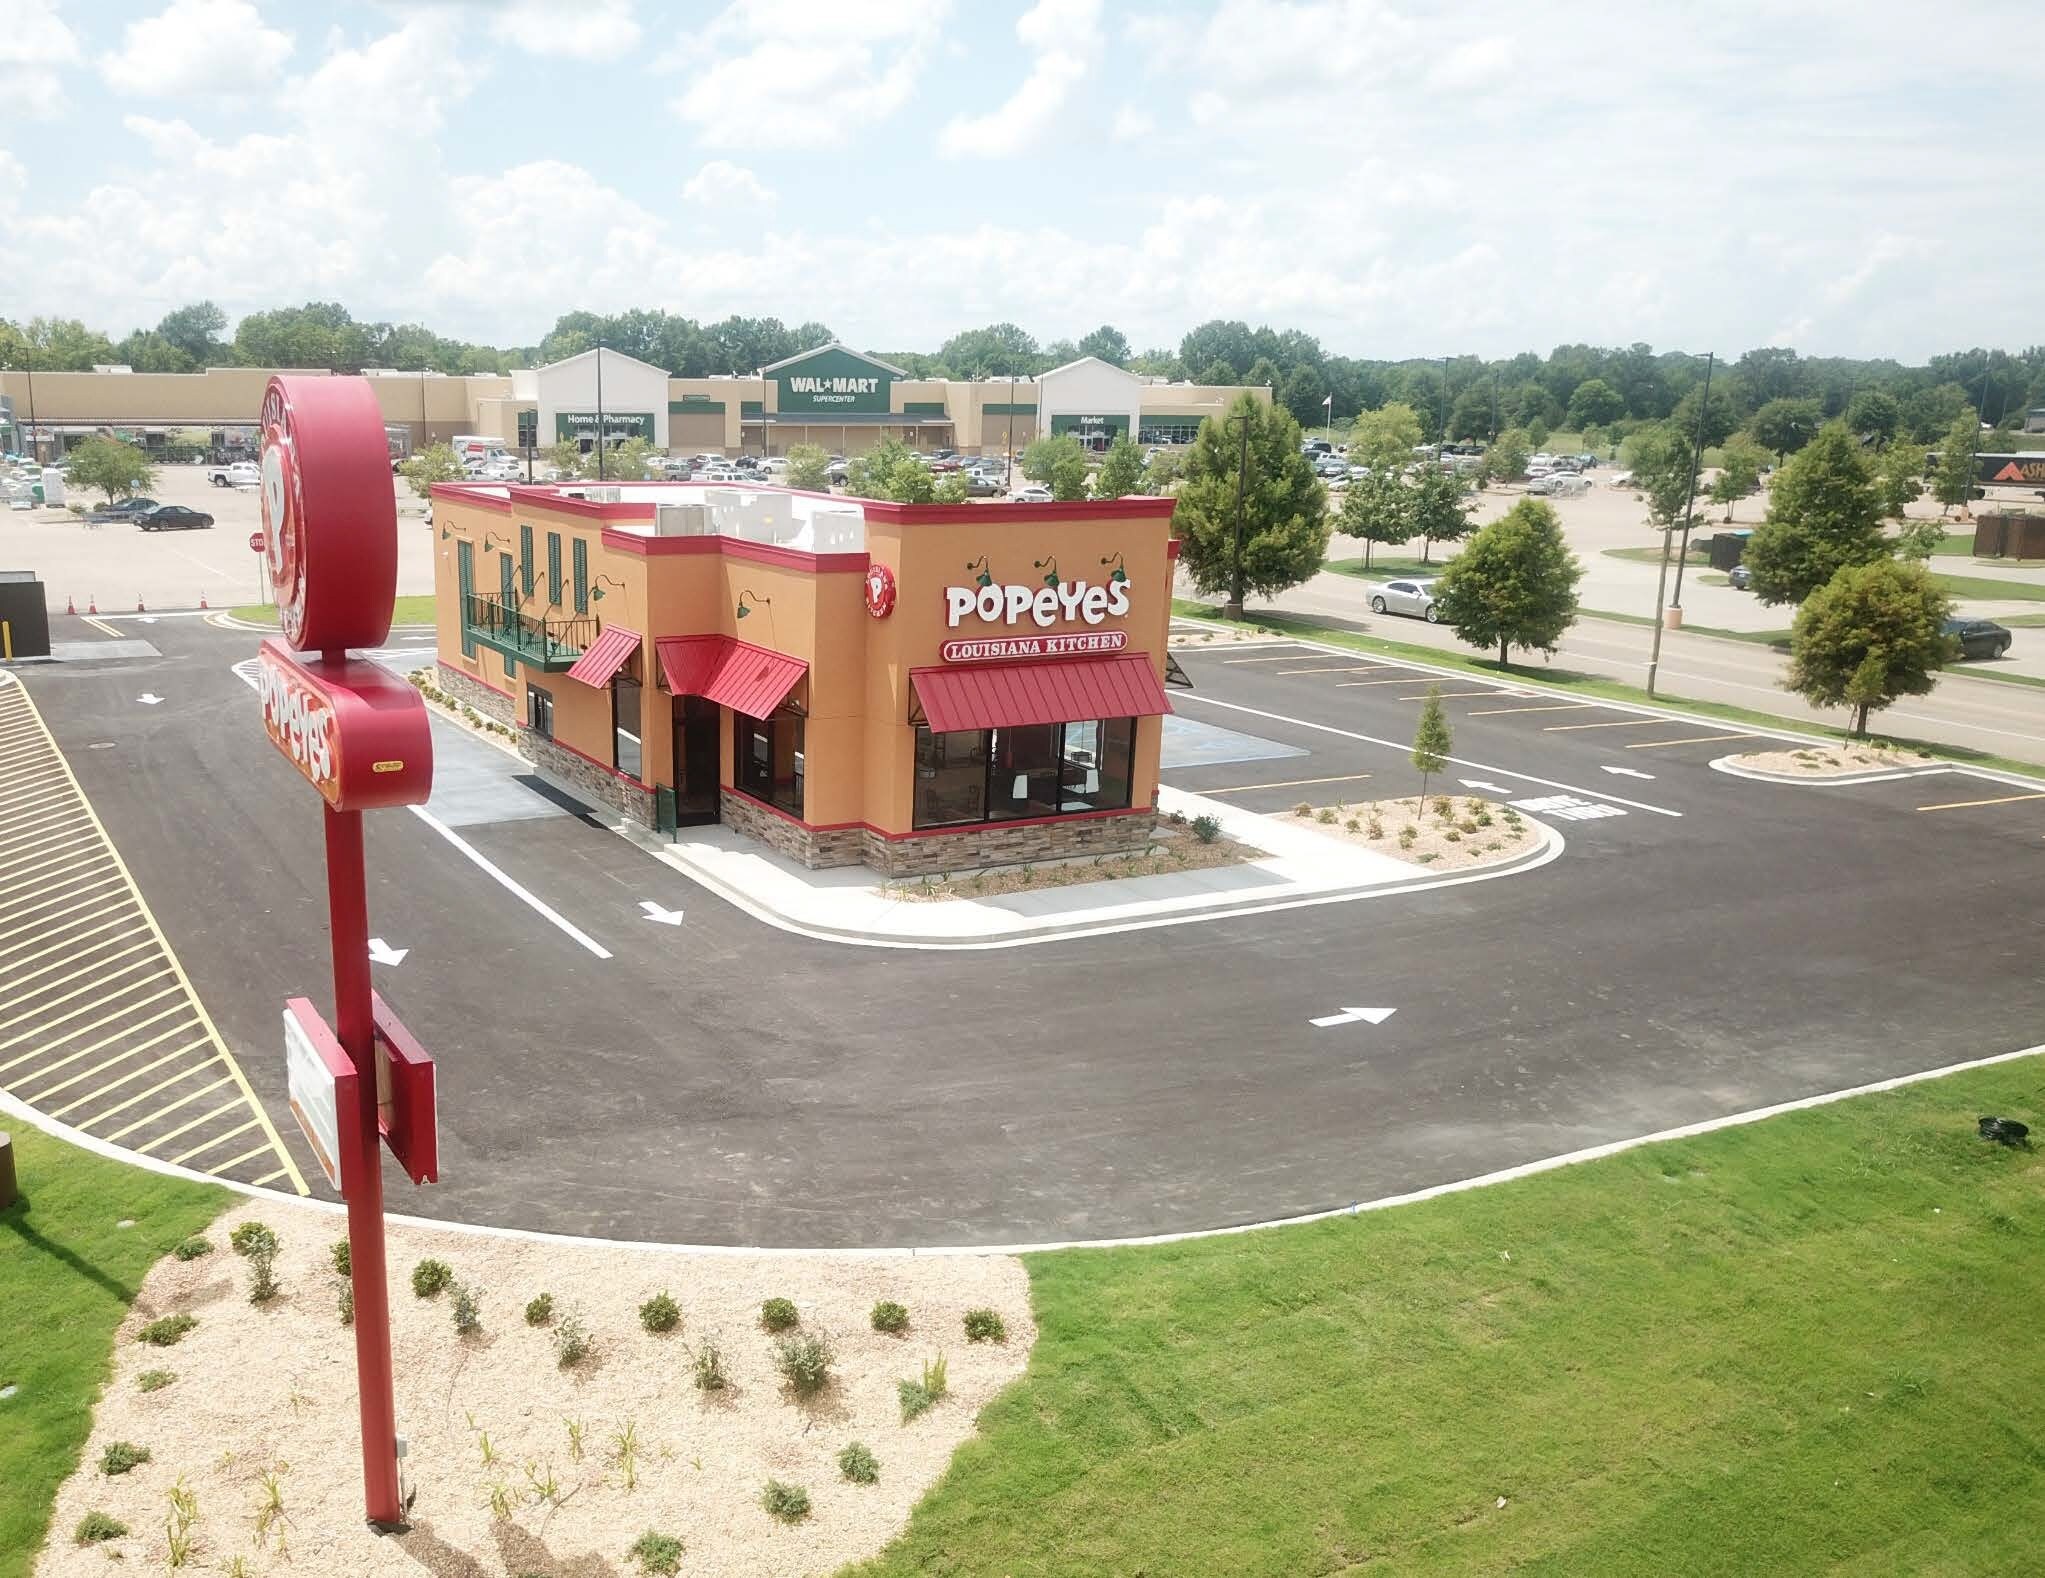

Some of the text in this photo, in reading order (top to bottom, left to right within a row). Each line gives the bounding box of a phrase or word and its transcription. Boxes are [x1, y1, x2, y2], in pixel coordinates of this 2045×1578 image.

[812, 395, 855, 403] SUPERCENTER
[568, 414, 593, 424] Home
[603, 414, 645, 425] Pharmacy
[1081, 416, 1104, 424] Market
[250, 538, 264, 547] STO
[951, 634, 1122, 659] LOUISIANA KITCHEN
